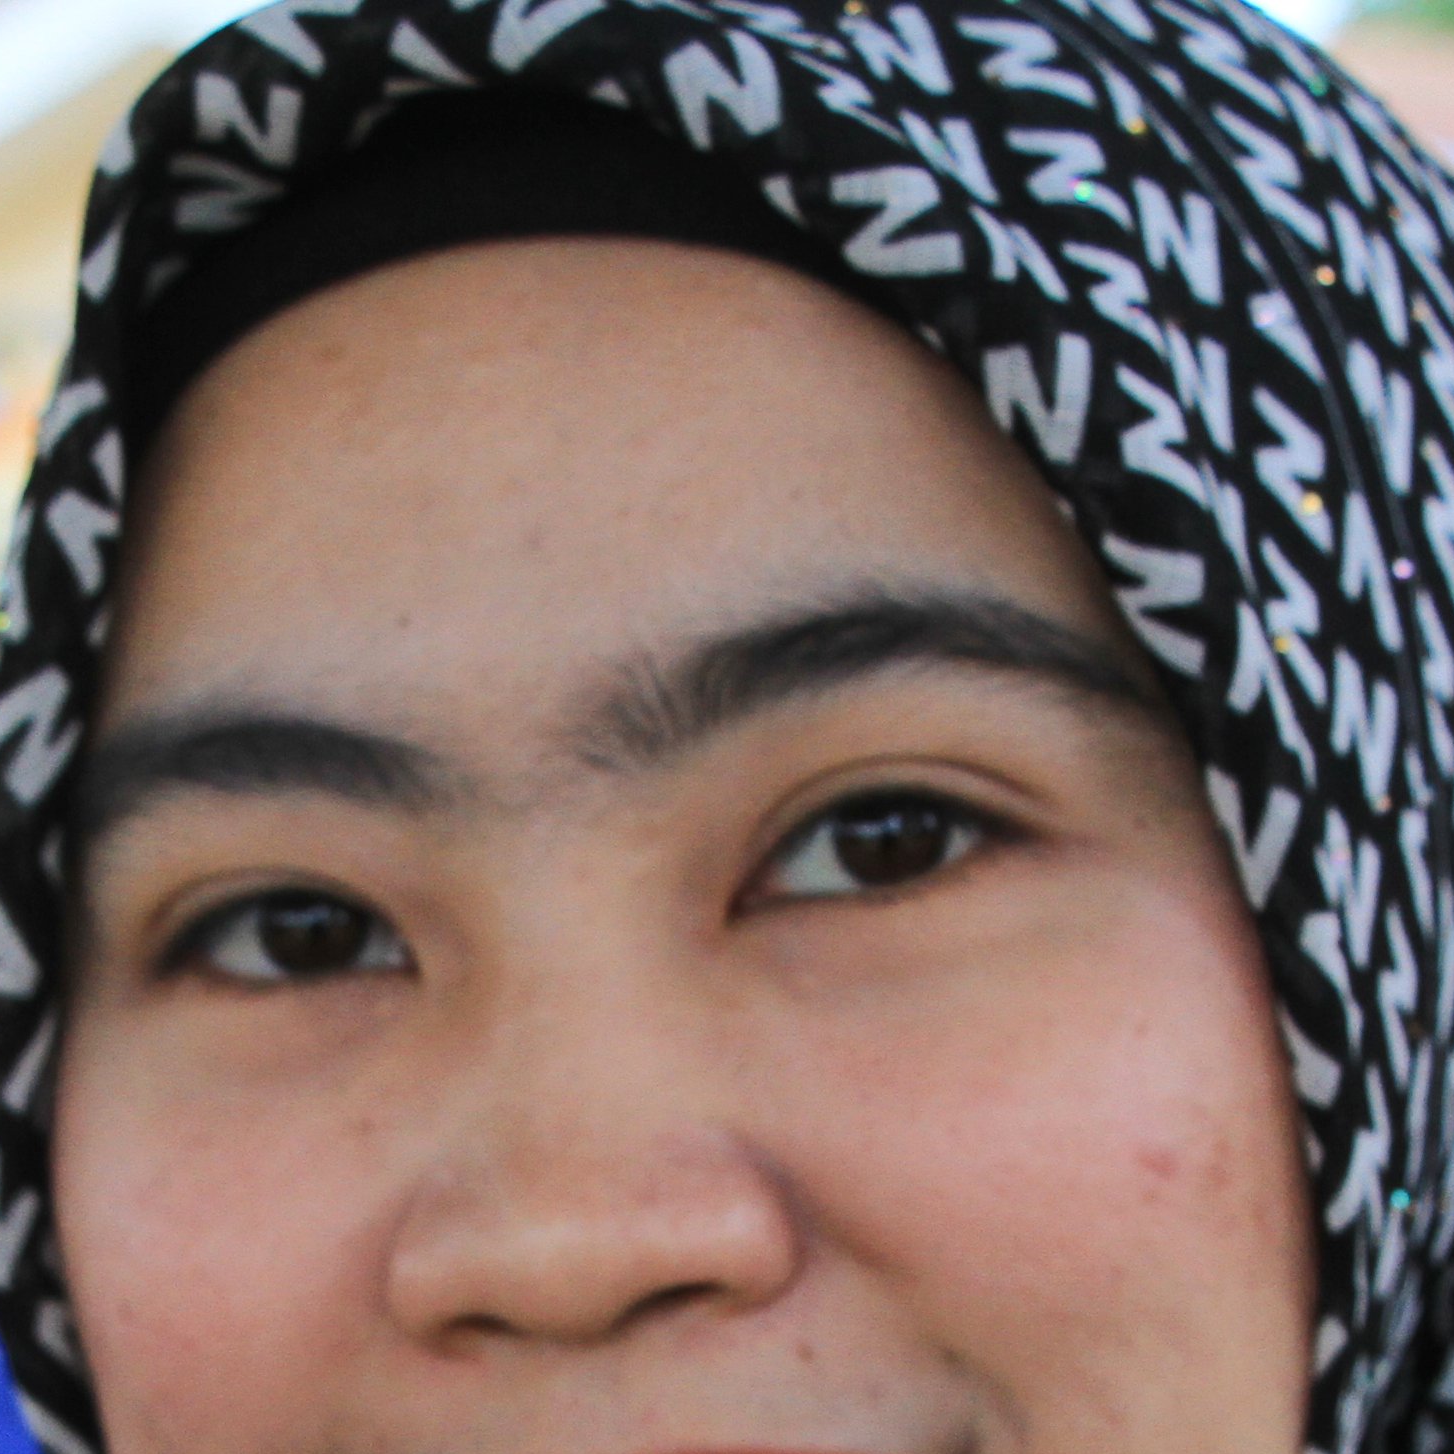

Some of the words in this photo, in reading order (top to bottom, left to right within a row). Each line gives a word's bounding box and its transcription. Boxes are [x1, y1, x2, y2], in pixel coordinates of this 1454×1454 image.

[195, 70, 303, 168] N
[664, 30, 783, 150] N
[1136, 177, 1221, 305] N
